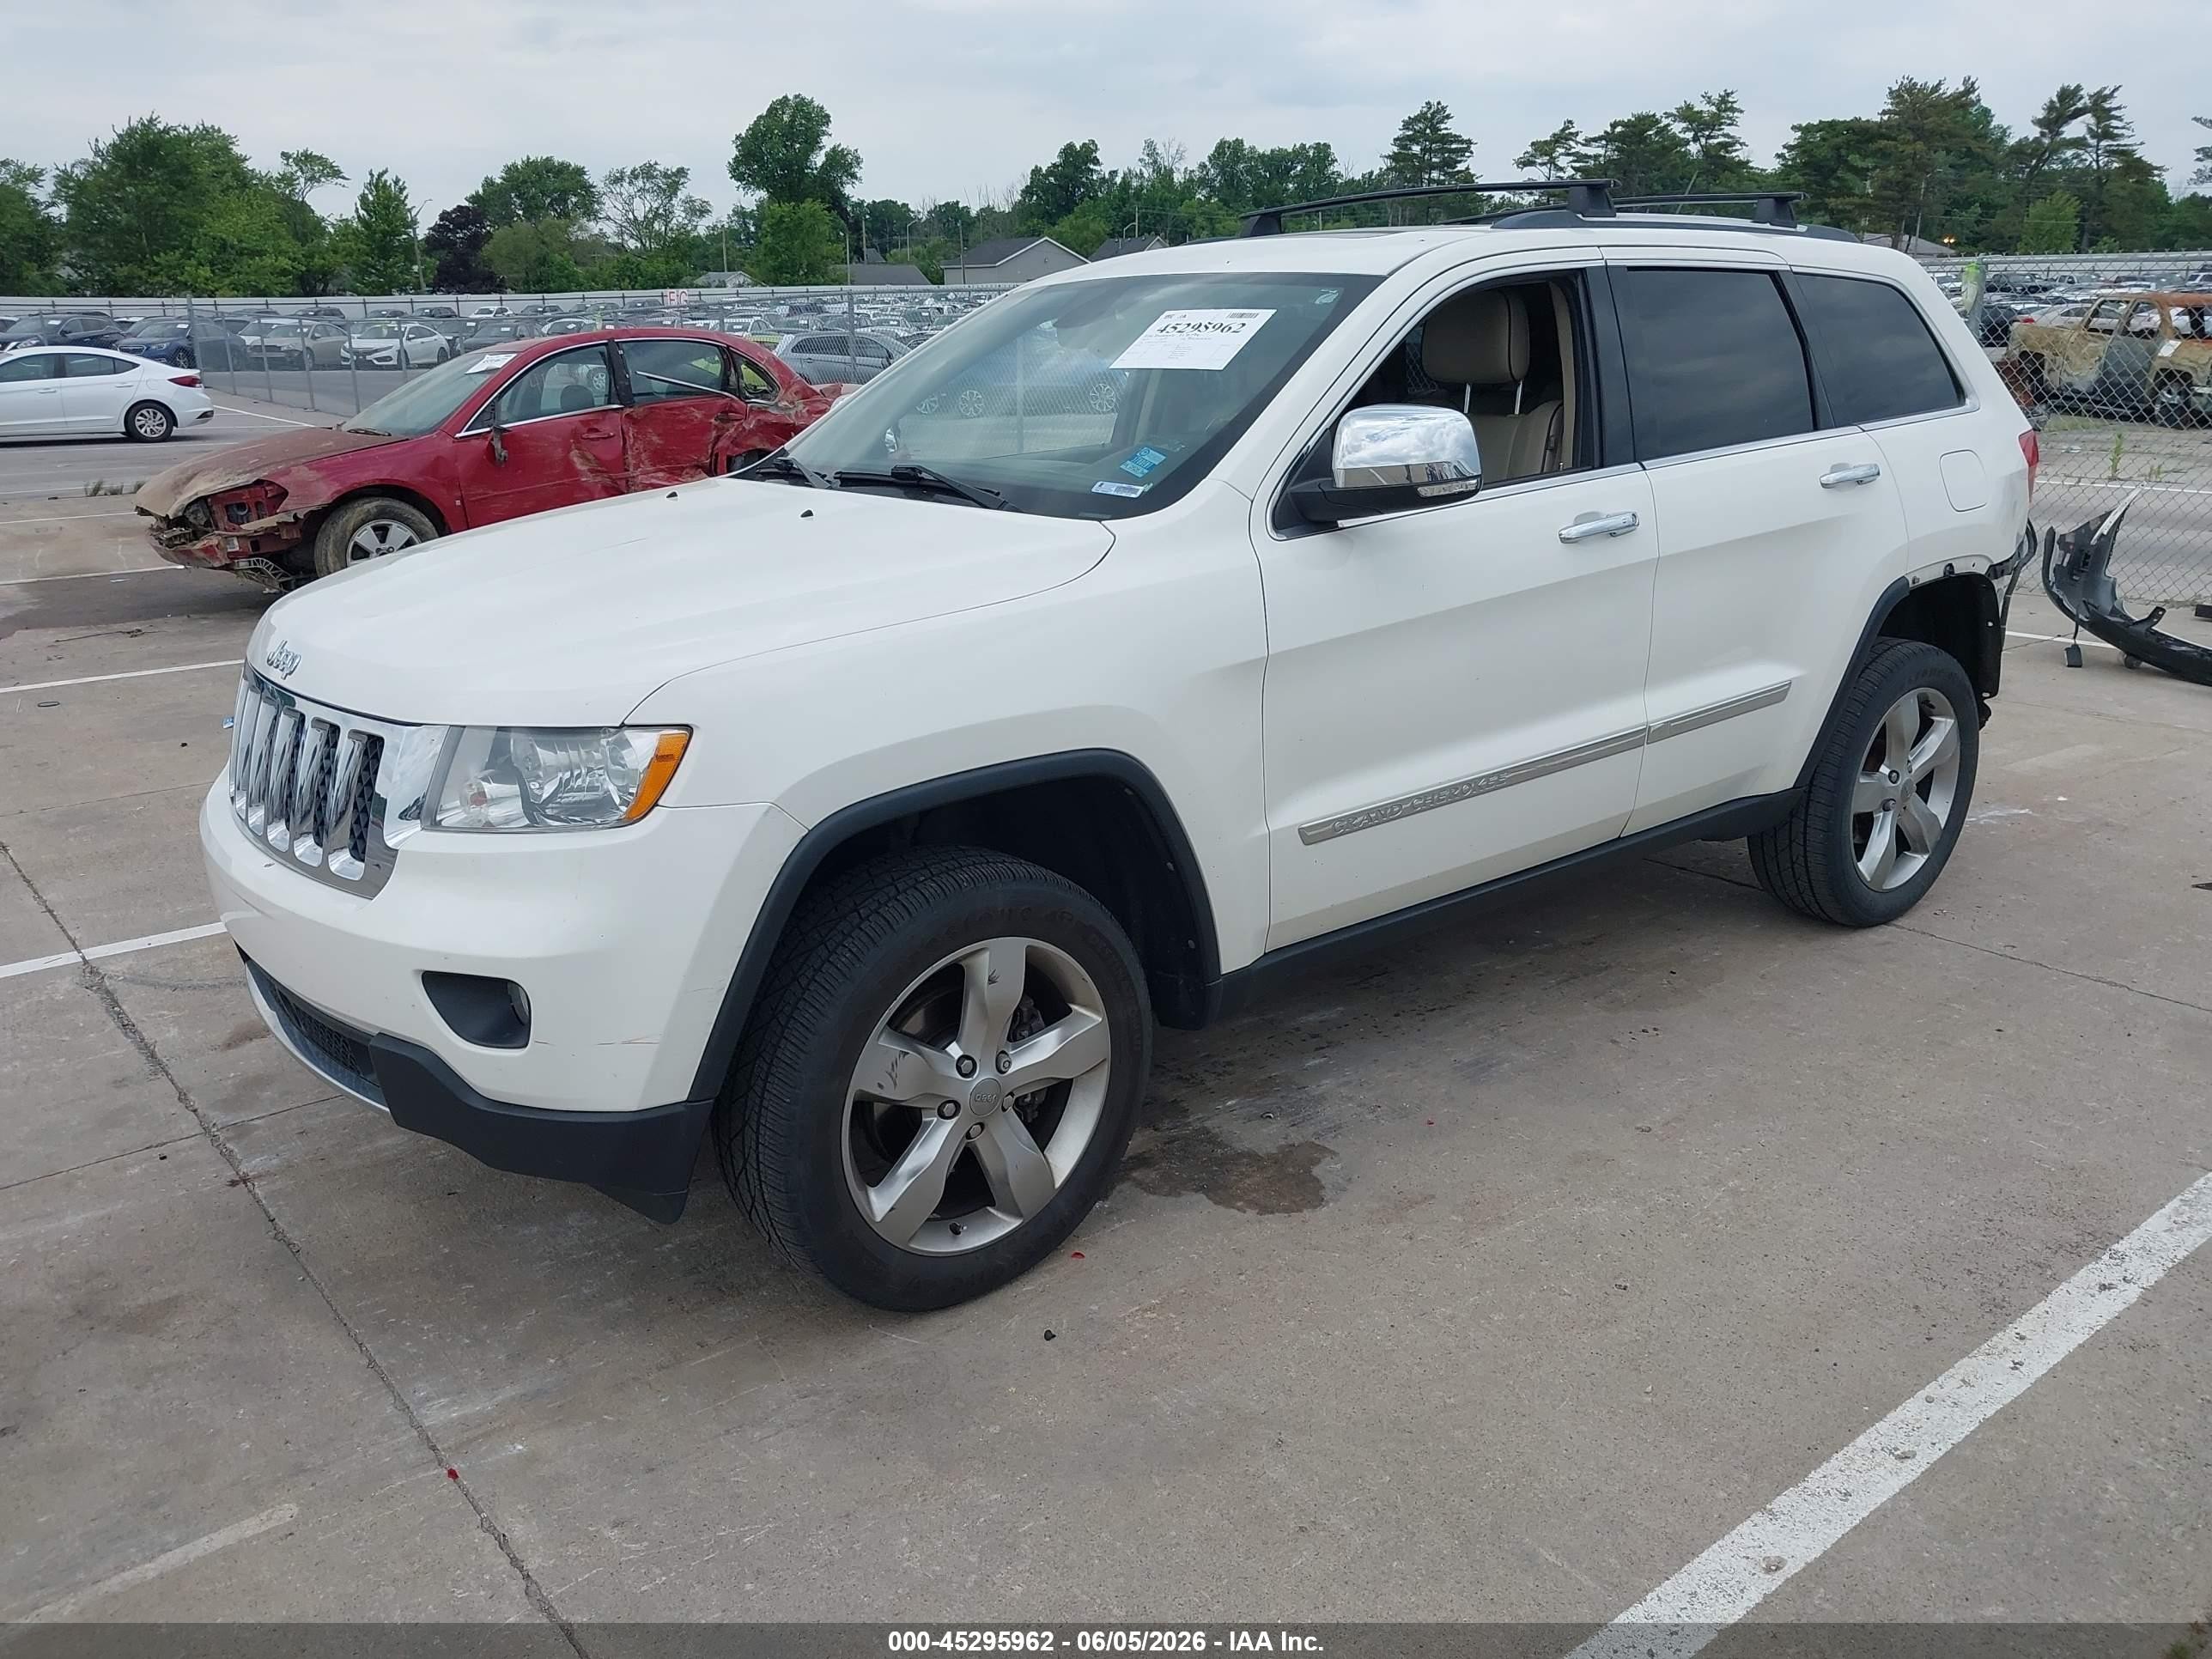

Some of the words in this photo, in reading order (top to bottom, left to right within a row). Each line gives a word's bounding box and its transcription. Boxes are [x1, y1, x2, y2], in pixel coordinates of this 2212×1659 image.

[1157, 321, 1247, 334] 45295962
[266, 640, 301, 680] Jeep
[1332, 803, 1404, 836] GRAND
[1410, 771, 1510, 811] CHEROKEE
